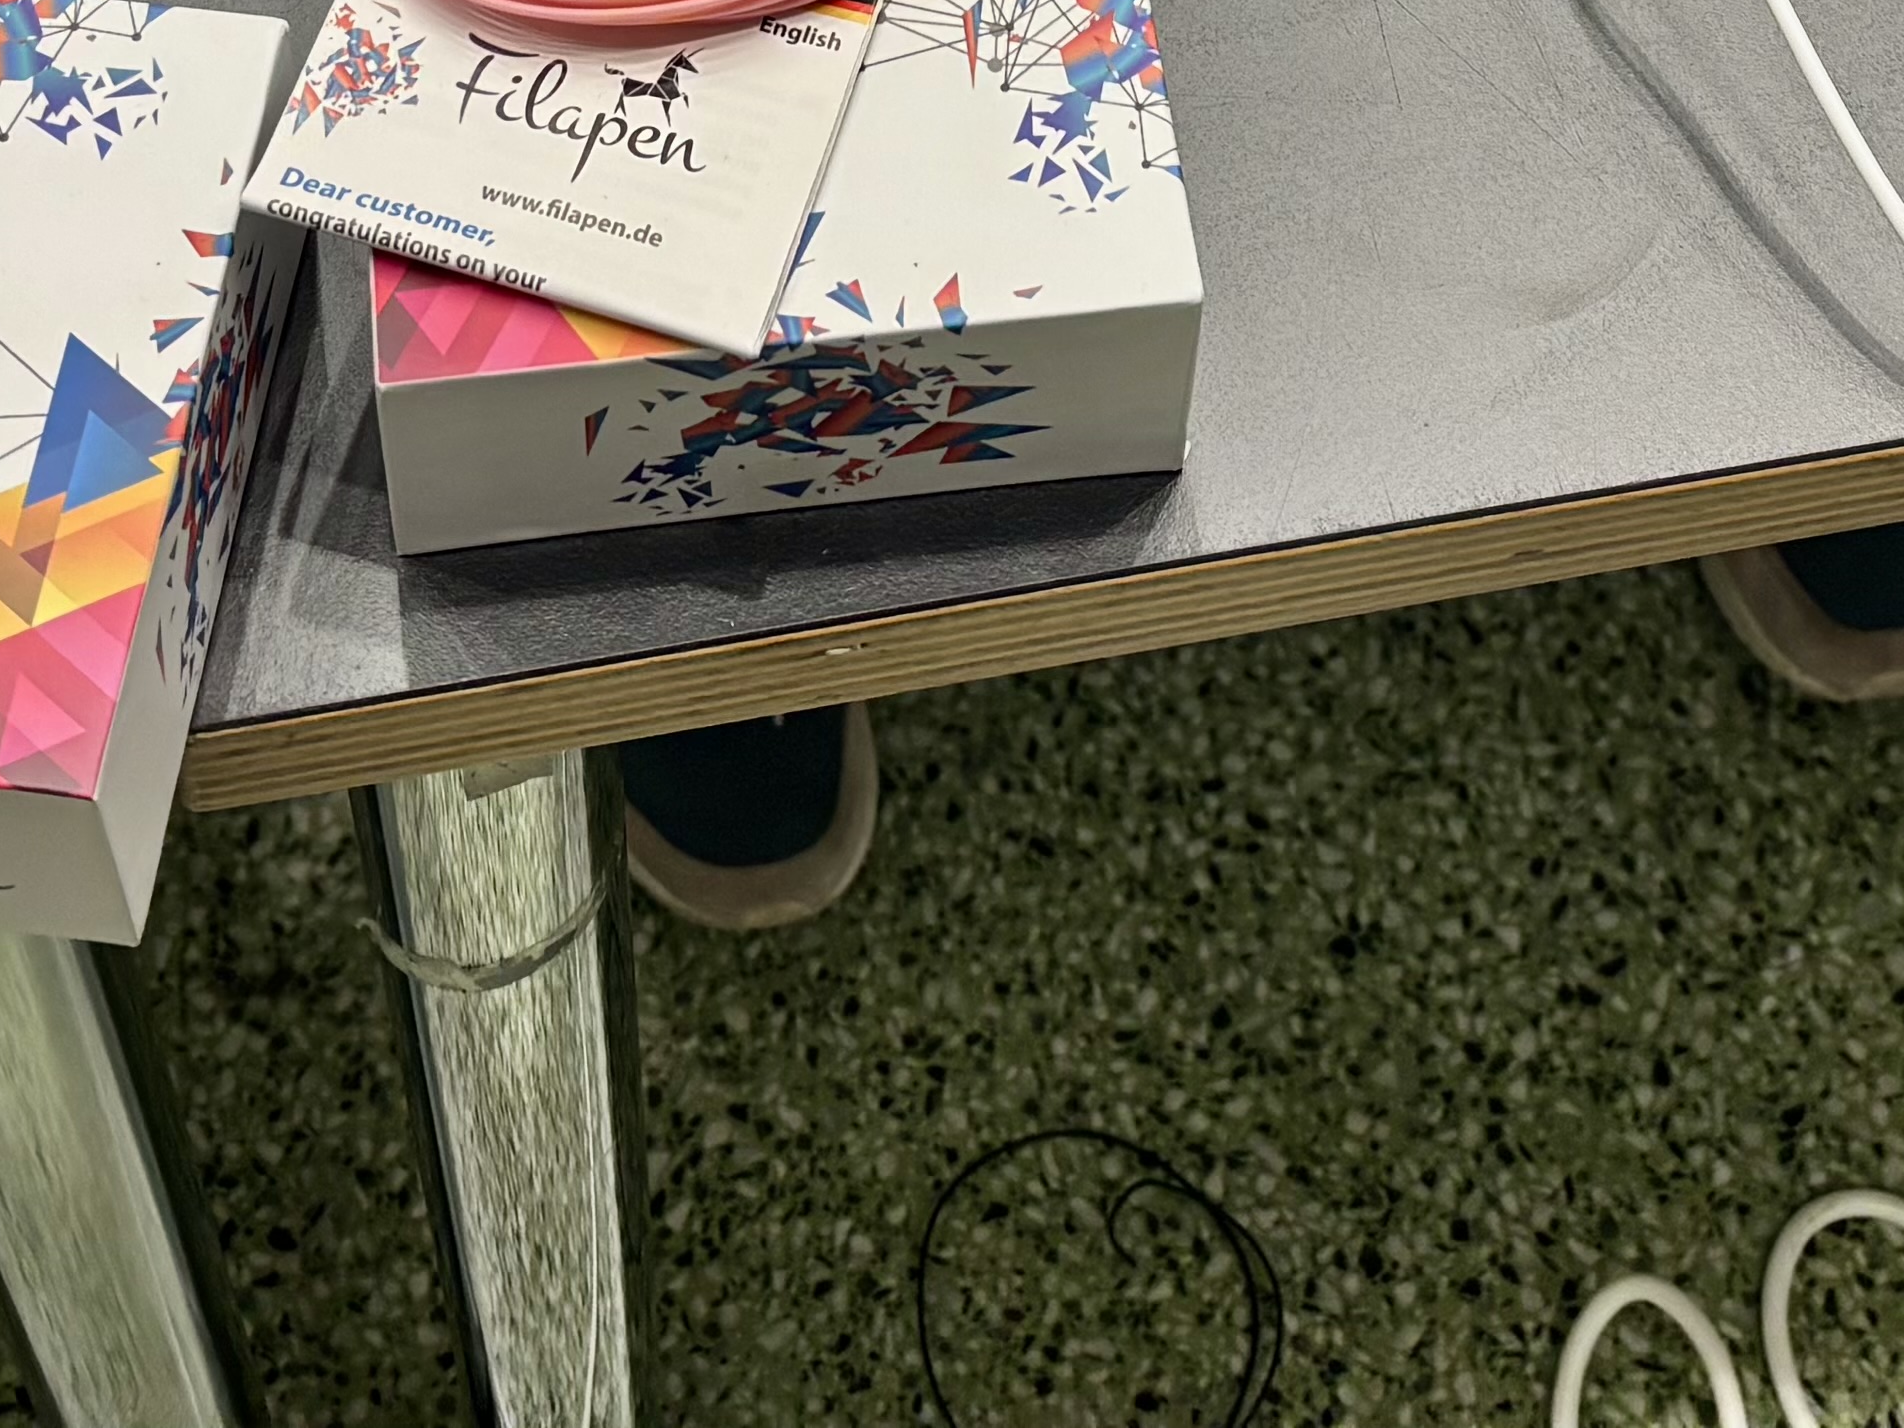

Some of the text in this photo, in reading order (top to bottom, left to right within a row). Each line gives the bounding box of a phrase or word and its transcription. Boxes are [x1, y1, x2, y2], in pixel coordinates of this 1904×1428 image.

[757, 14, 843, 54] English
[453, 30, 707, 182] Filapen
[266, 196, 548, 293] congratulations on your
[279, 165, 497, 248] Dear customer,
[480, 183, 664, 248] www.filapen.de
